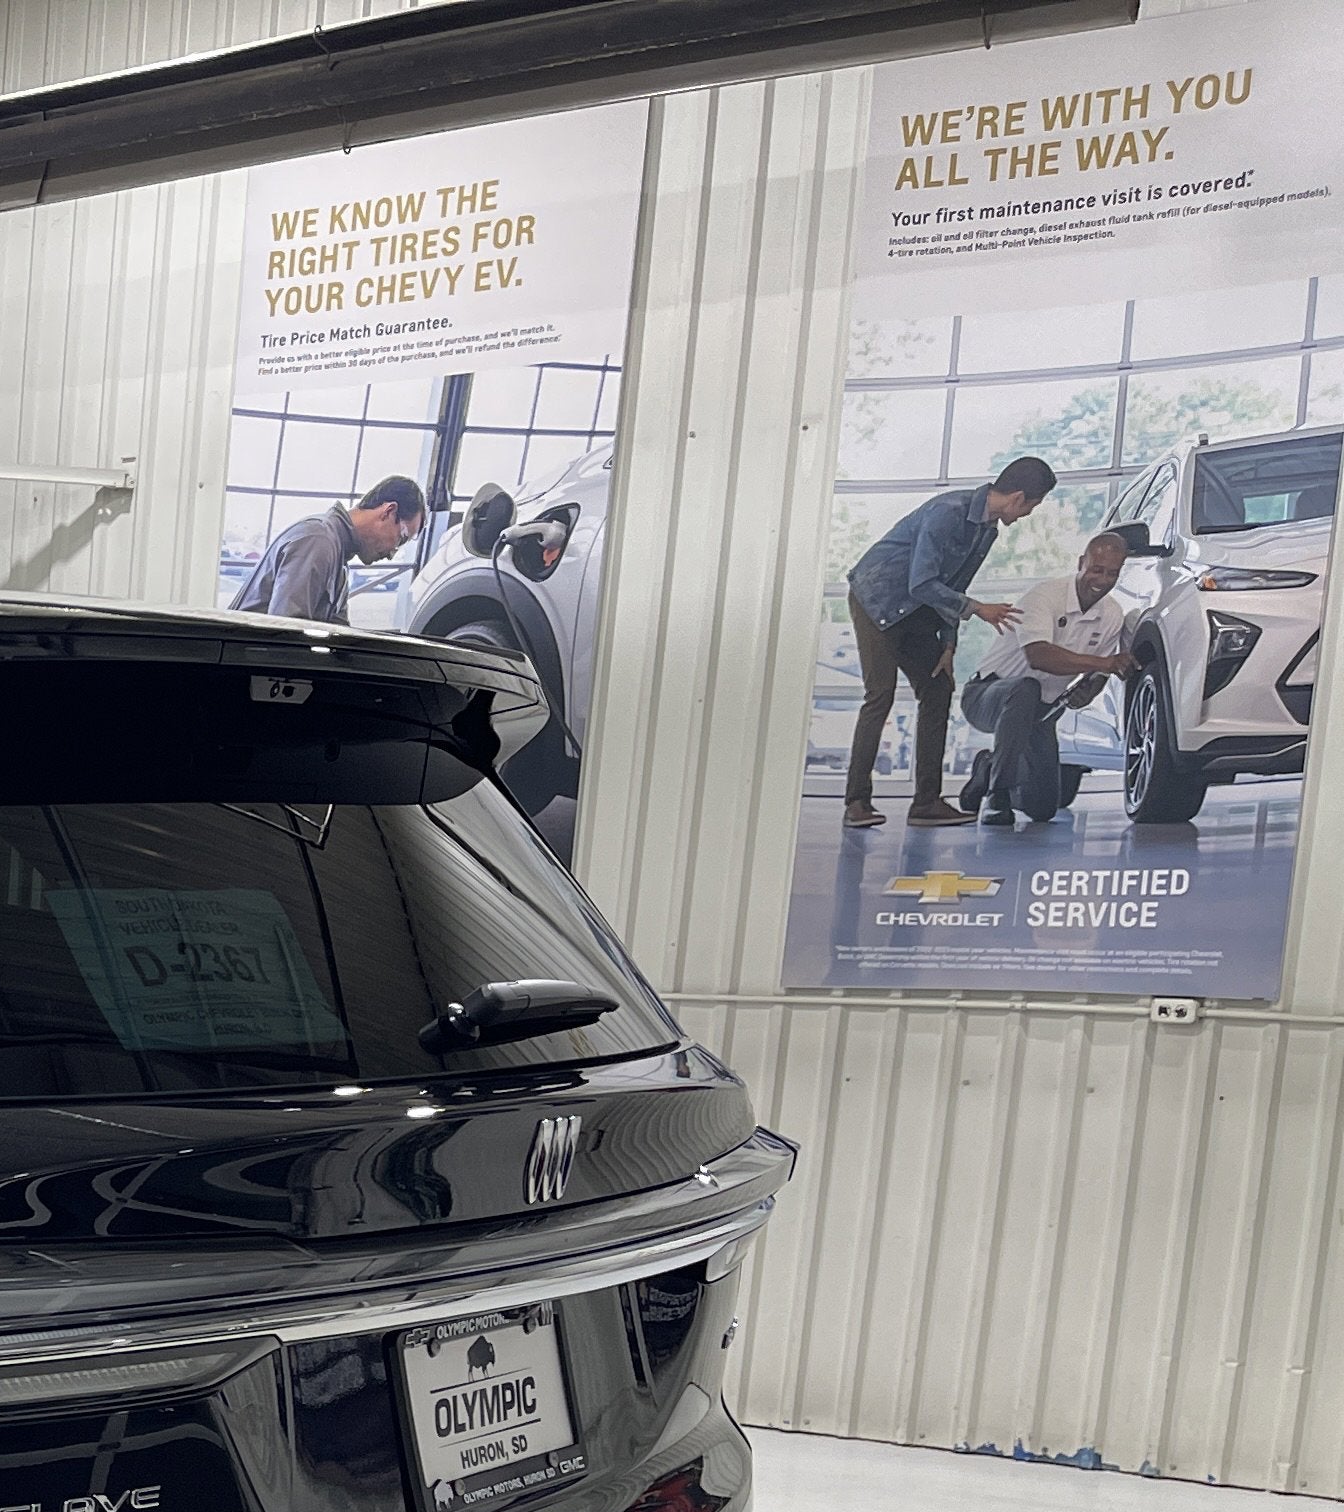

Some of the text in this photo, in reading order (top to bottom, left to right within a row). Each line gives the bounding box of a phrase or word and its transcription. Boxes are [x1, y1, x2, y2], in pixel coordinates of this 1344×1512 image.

[900, 68, 1253, 148] WE'RE WITH YOU
[894, 126, 1176, 192] ALL THE WAY.
[271, 179, 501, 242] WE KNOW THE
[889, 236, 929, 246] Includes:
[931, 233, 942, 243] oil
[944, 232, 961, 242] and
[975, 229, 999, 239] filter
[1001, 226, 1037, 237] change,
[1039, 221, 1067, 233] diesel
[1069, 219, 1106, 230] exhaust
[1108, 214, 1131, 225] fluid
[1132, 211, 1154, 222] tank
[1156, 208, 1180, 219] refill
[1182, 205, 1201, 217] (for
[1203, 194, 1284, 213] diesel-equipped
[891, 212, 931, 228] Your
[935, 206, 975, 224] first
[979, 195, 1096, 220] maintenance
[1102, 187, 1141, 206] visit
[1147, 184, 1162, 201] is
[267, 214, 537, 280] RIGHT TIRES FOR
[888, 230, 1116, 257] 4-tire rotation, and Multi-Point Vehicle Inspection.
[264, 257, 524, 318] YOUR CHEVY EV.
[261, 315, 453, 349] Tire Price Match Guarantee.
[320, 350, 343, 359] better
[1030, 869, 1191, 897] CERTIFIED
[875, 901, 1160, 929] CHEVROLET SERVICE
[123, 941, 271, 987] D-2367
[436, 1318, 476, 1340] OLYMPIC
[434, 1376, 537, 1438] OLYMPIC
[460, 1434, 528, 1470] HURON, SD
[463, 1456, 585, 1504] OLYMPIC MOTORS, HURON SD GMC
